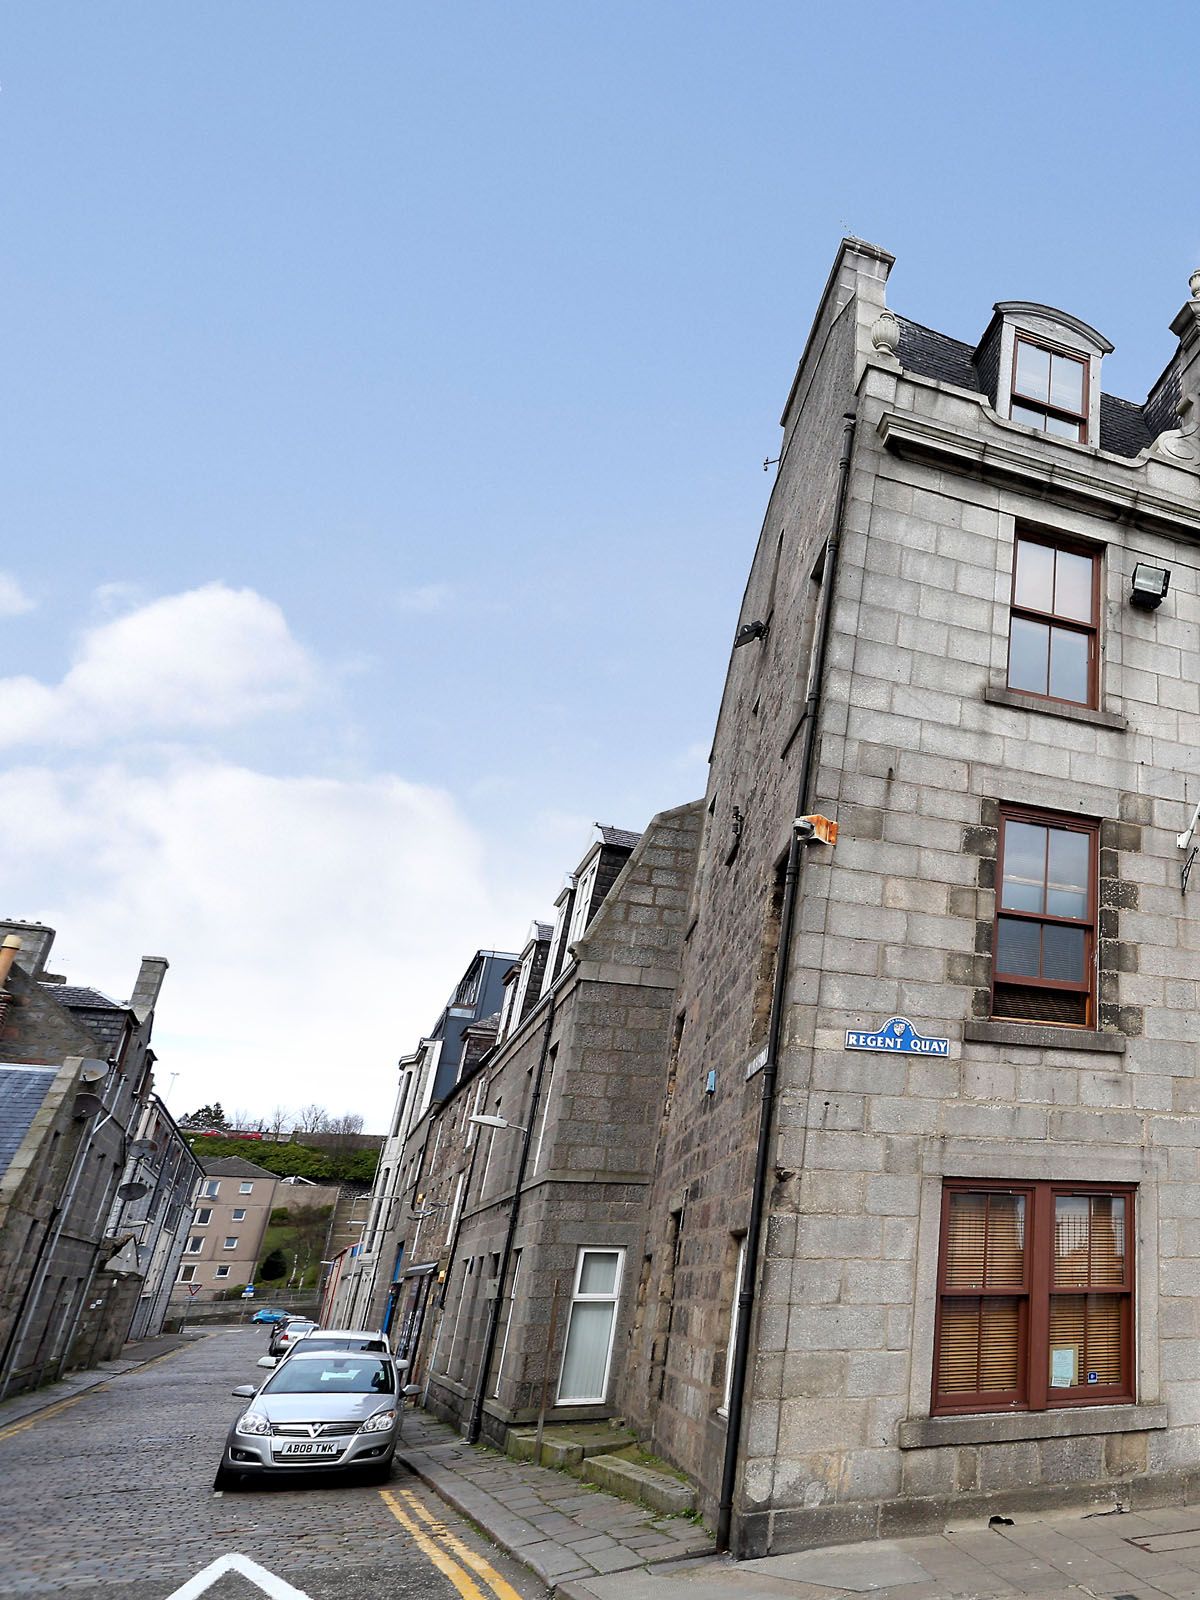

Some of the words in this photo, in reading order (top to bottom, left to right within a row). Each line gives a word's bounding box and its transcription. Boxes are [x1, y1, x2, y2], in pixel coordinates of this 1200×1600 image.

[848, 1034, 903, 1049] REGENT
[910, 1039, 947, 1052] QUAY
[286, 1444, 313, 1453] AB08
